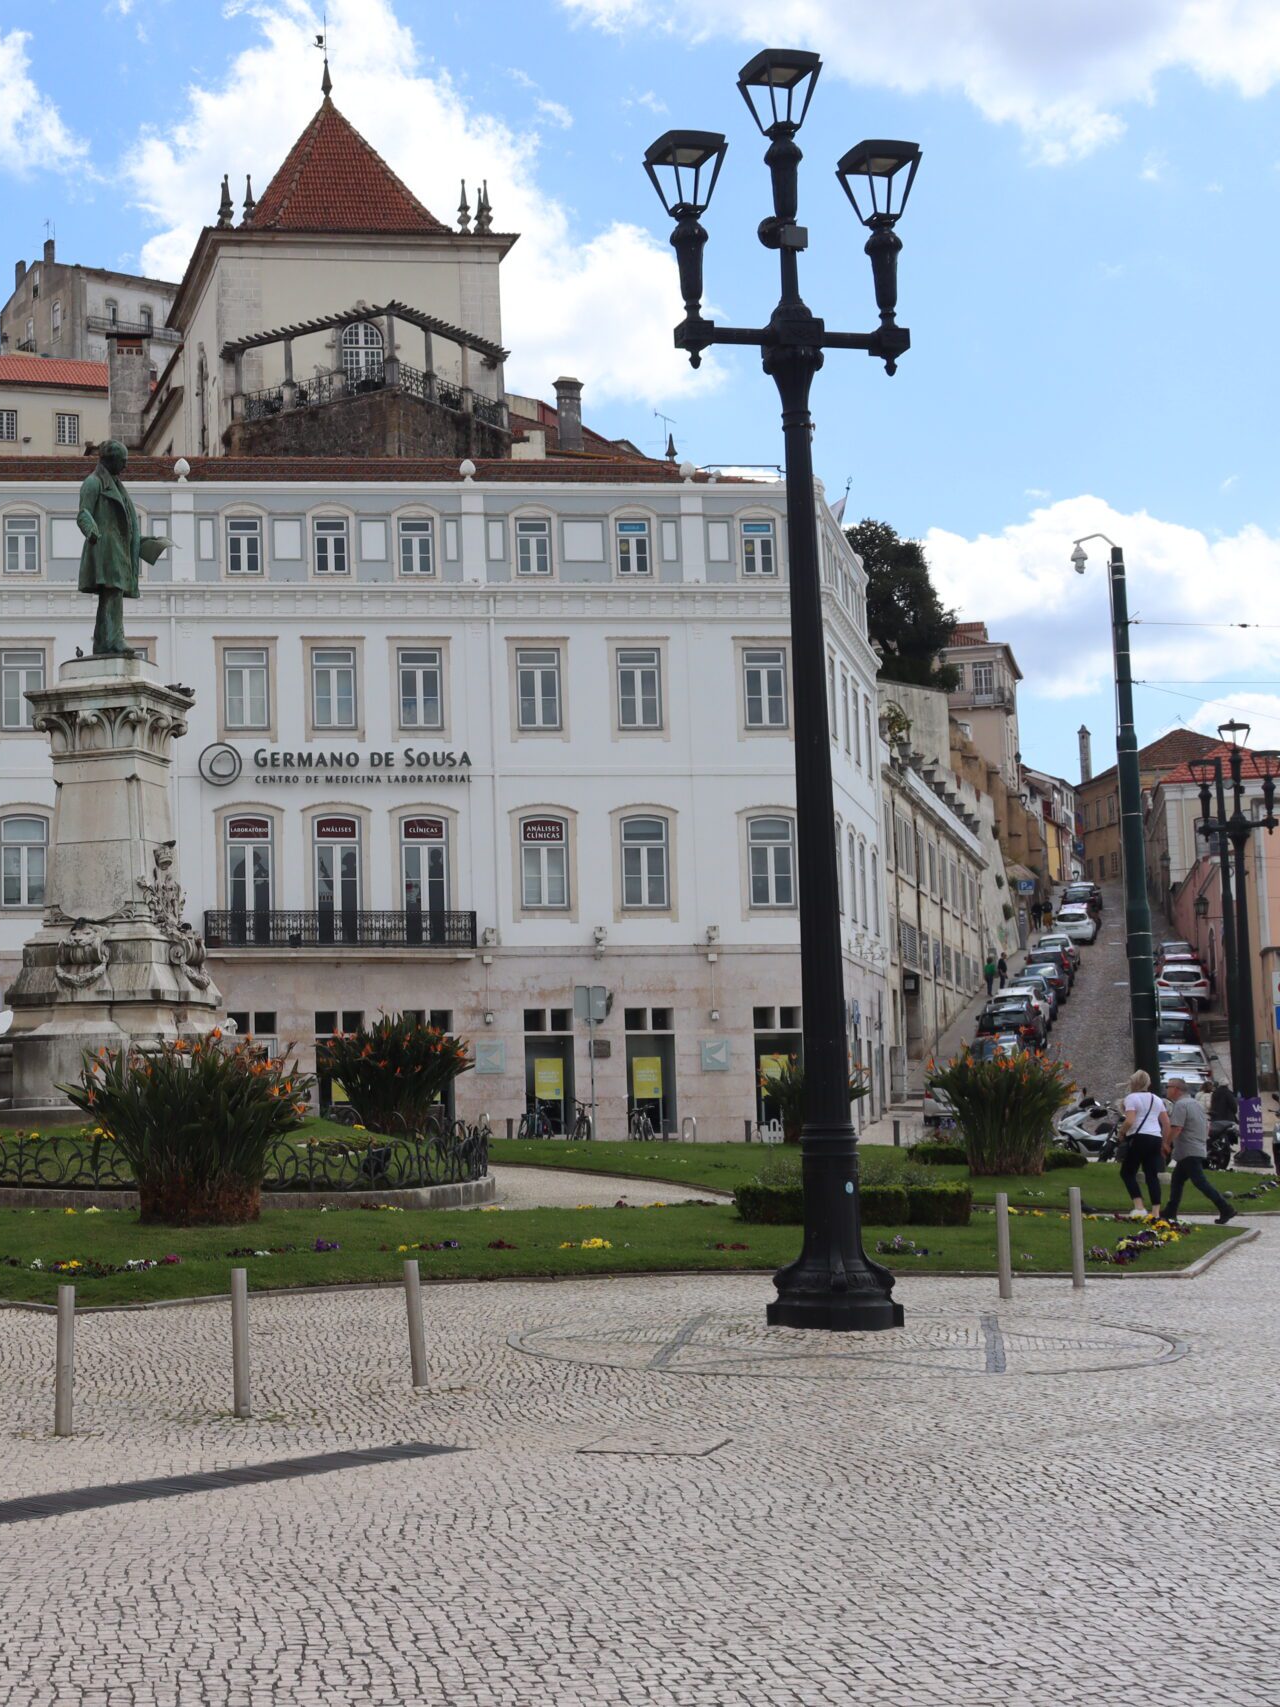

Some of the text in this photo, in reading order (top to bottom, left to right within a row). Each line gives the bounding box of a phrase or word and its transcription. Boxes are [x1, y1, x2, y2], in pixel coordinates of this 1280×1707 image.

[253, 747, 473, 768] GERMANO DE SOUSA
[254, 774, 473, 784] CENTRO DE MEDICINA LABORATORIAL
[321, 825, 353, 833] ANÁLISES
[526, 824, 560, 832] ANÁLISES
